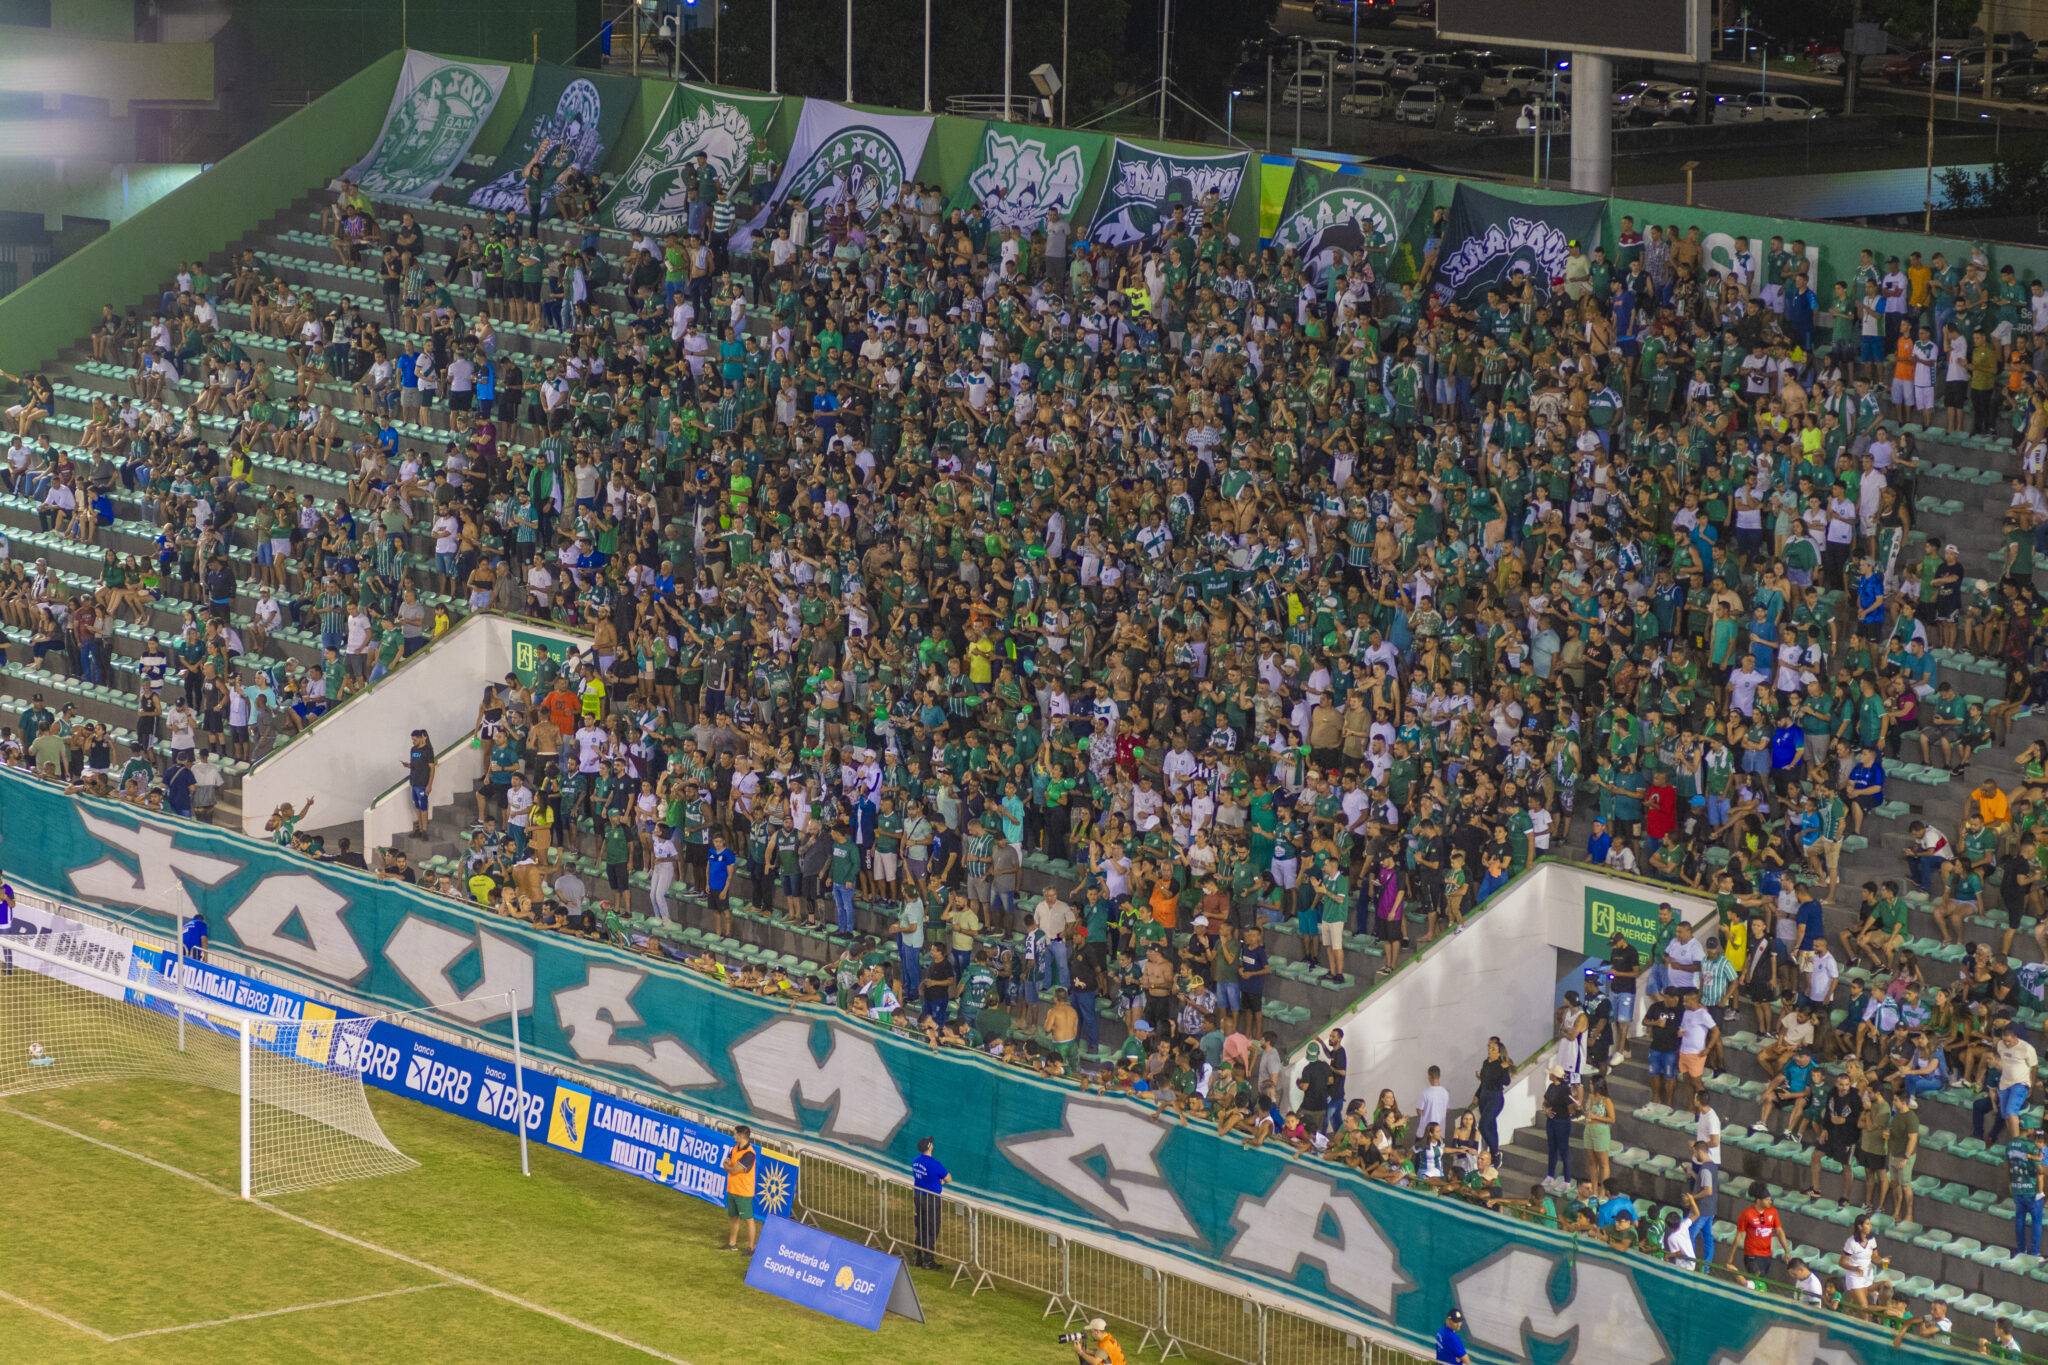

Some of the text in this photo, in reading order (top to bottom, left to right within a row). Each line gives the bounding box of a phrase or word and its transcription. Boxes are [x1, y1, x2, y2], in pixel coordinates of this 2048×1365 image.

[1615, 911, 1657, 931] SAÍDA DE
[163, 958, 237, 1003] CANDANGÃO
[246, 990, 269, 1013] BRB
[269, 993, 302, 1021] 2024
[358, 1039, 400, 1081] BRB
[413, 1041, 435, 1056] banco
[427, 1061, 472, 1105] BRB
[485, 1065, 506, 1081] banco
[499, 1086, 545, 1130] BRB
[593, 1102, 680, 1153] CANDANGÃO
[693, 1138, 718, 1165] BRB
[610, 1138, 656, 1174] MUITO
[675, 1159, 727, 1200] FUTEBOL
[763, 1256, 825, 1288] Esporte e Lazer
[778, 1244, 830, 1272] Secretaria de
[853, 1278, 876, 1295] GDF
